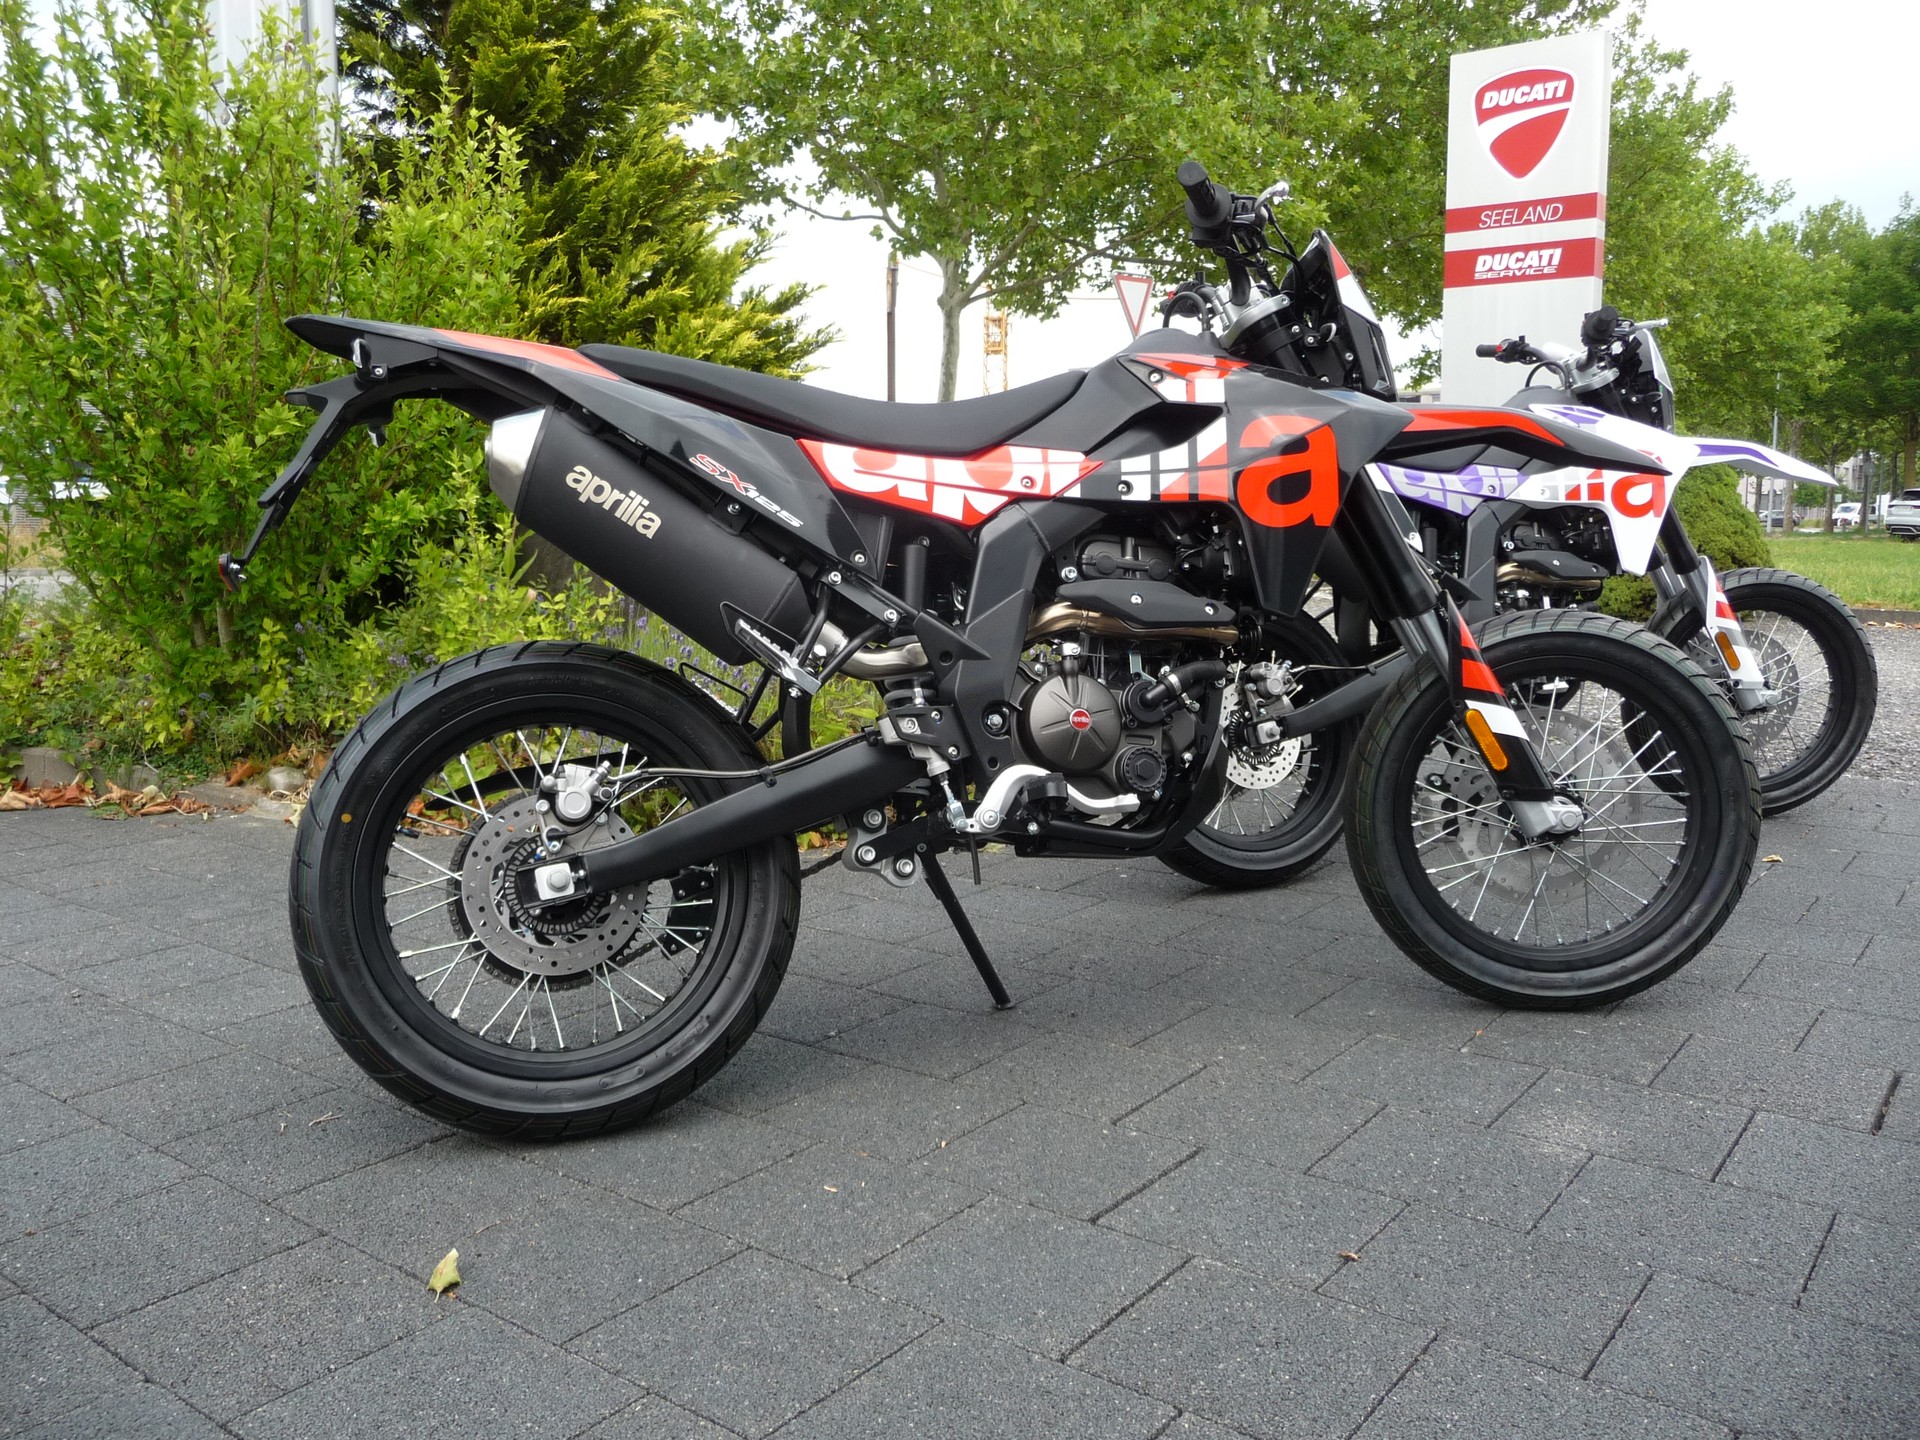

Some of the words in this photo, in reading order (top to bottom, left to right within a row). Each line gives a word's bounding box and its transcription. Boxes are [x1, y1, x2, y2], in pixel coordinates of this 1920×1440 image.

[1482, 79, 1567, 110] DUCATI
[1479, 203, 1563, 228] SEELAND
[1475, 248, 1562, 272] DUCATI
[1474, 266, 1557, 280] SERVICE
[565, 465, 662, 539] aprilia
